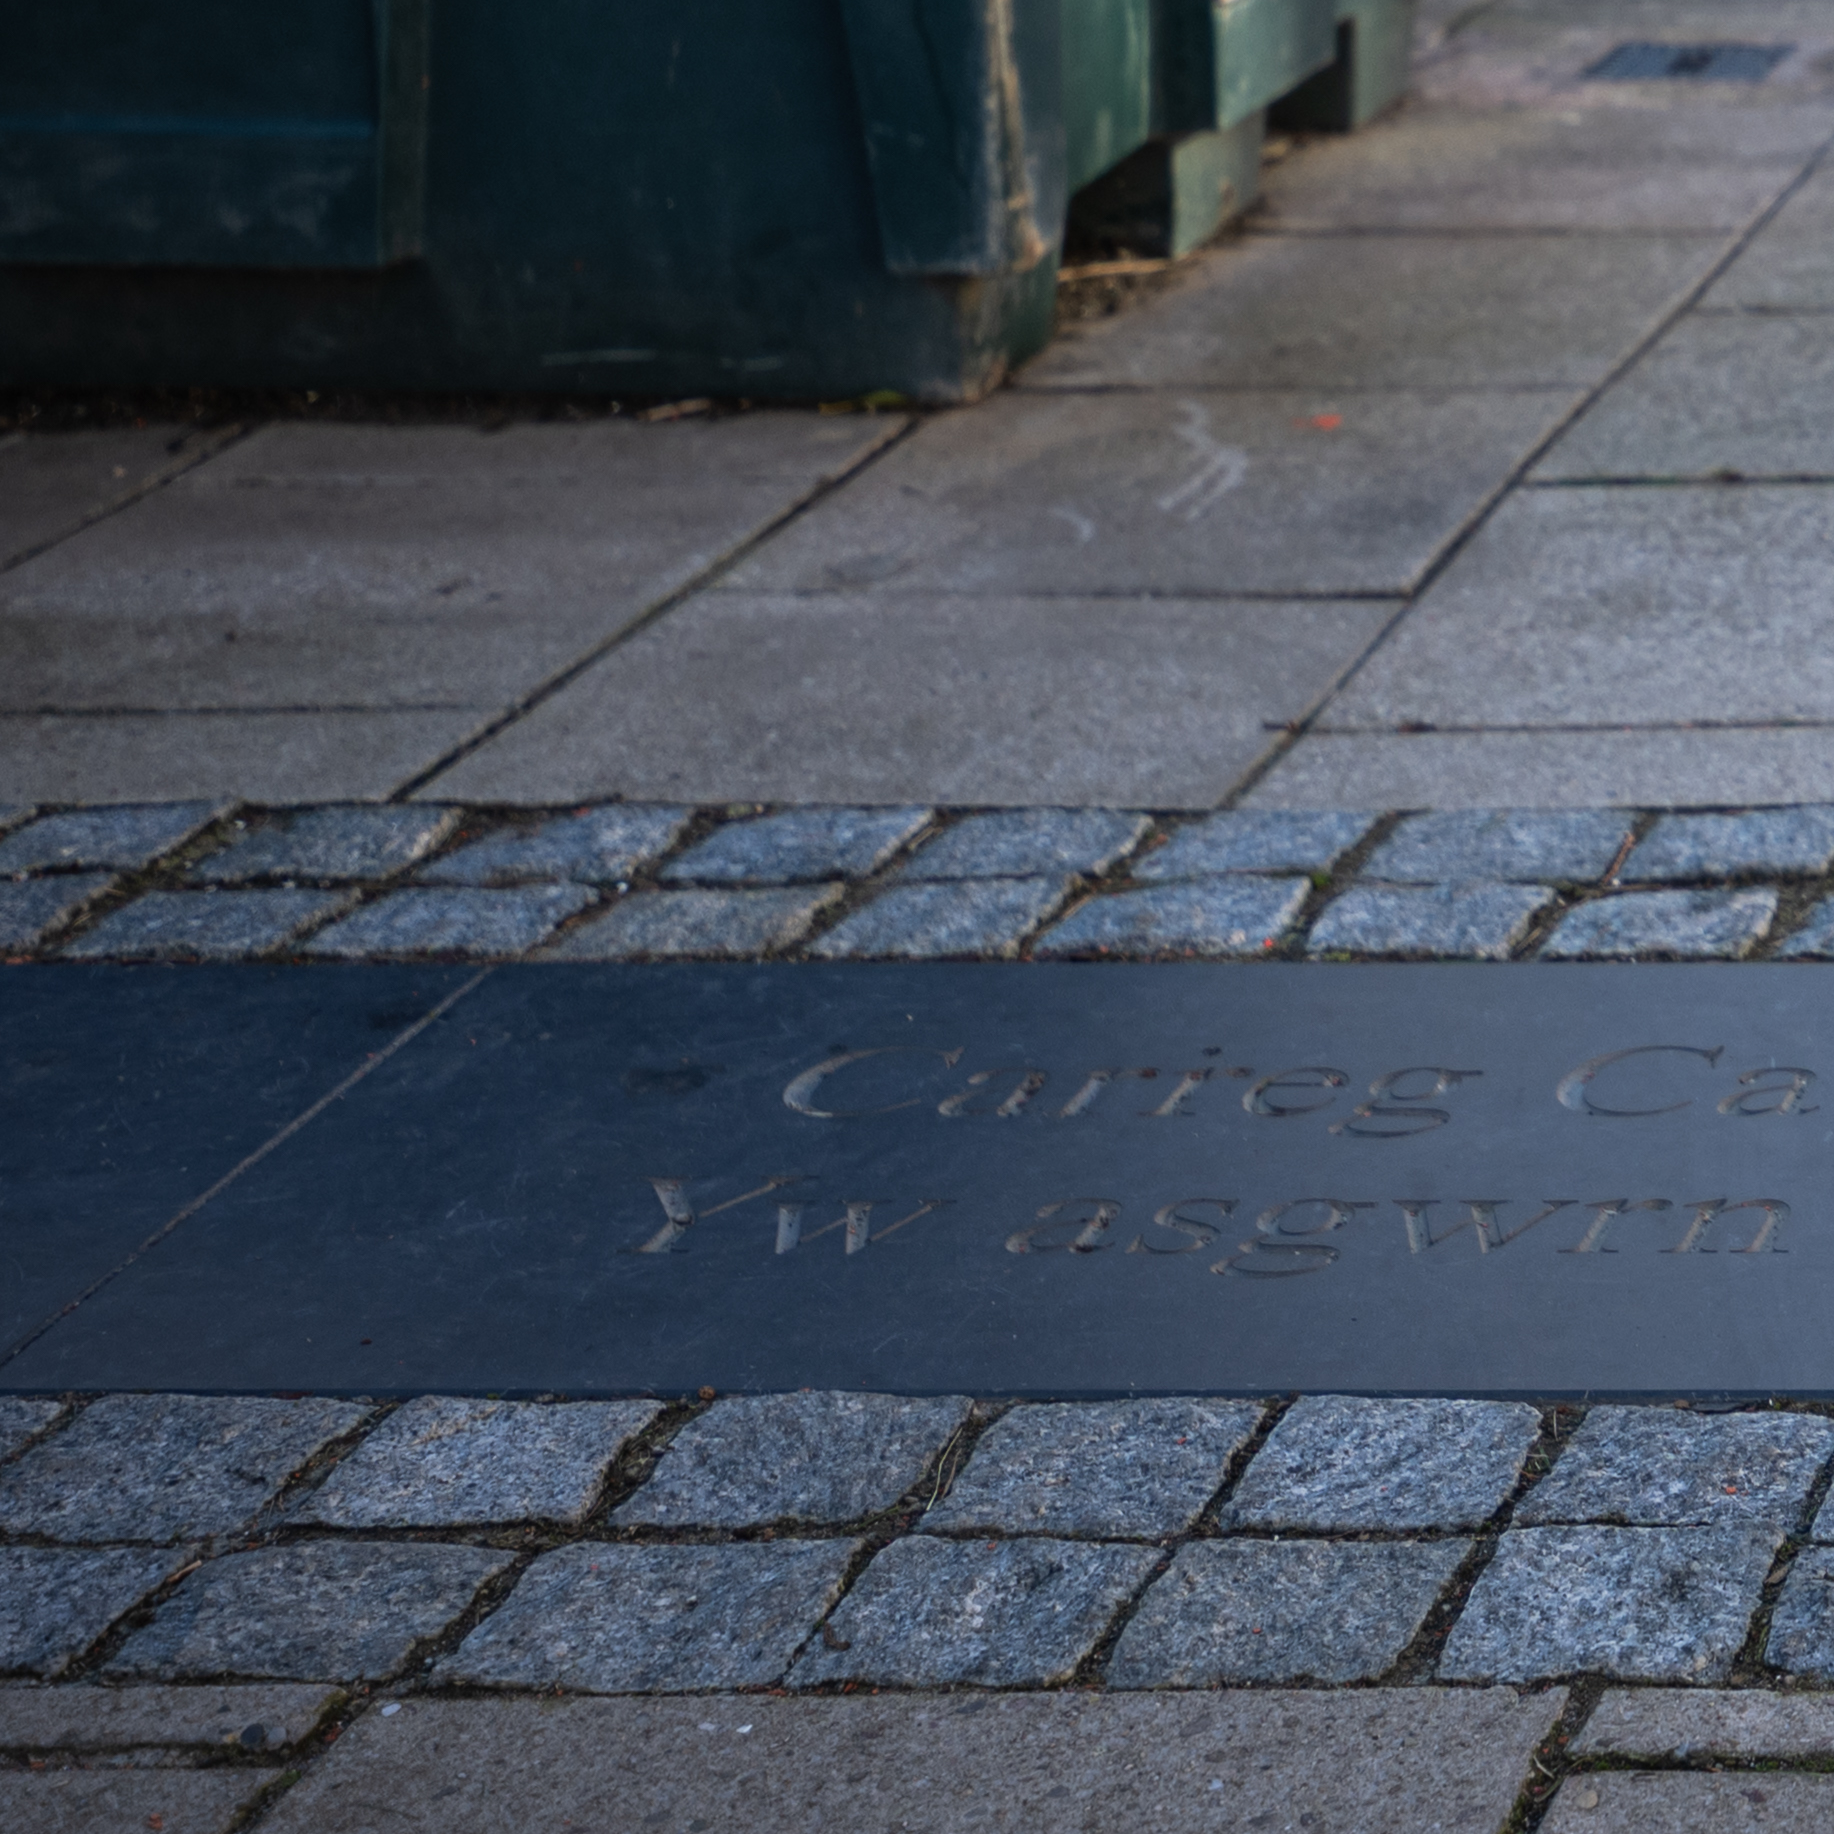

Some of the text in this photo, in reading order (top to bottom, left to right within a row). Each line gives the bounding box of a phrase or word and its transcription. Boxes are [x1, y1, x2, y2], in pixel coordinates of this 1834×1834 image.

[782, 1045, 1483, 1138] Carreg
[616, 1177, 958, 1255] Yw
[1005, 1198, 1791, 1280] asgwrn
